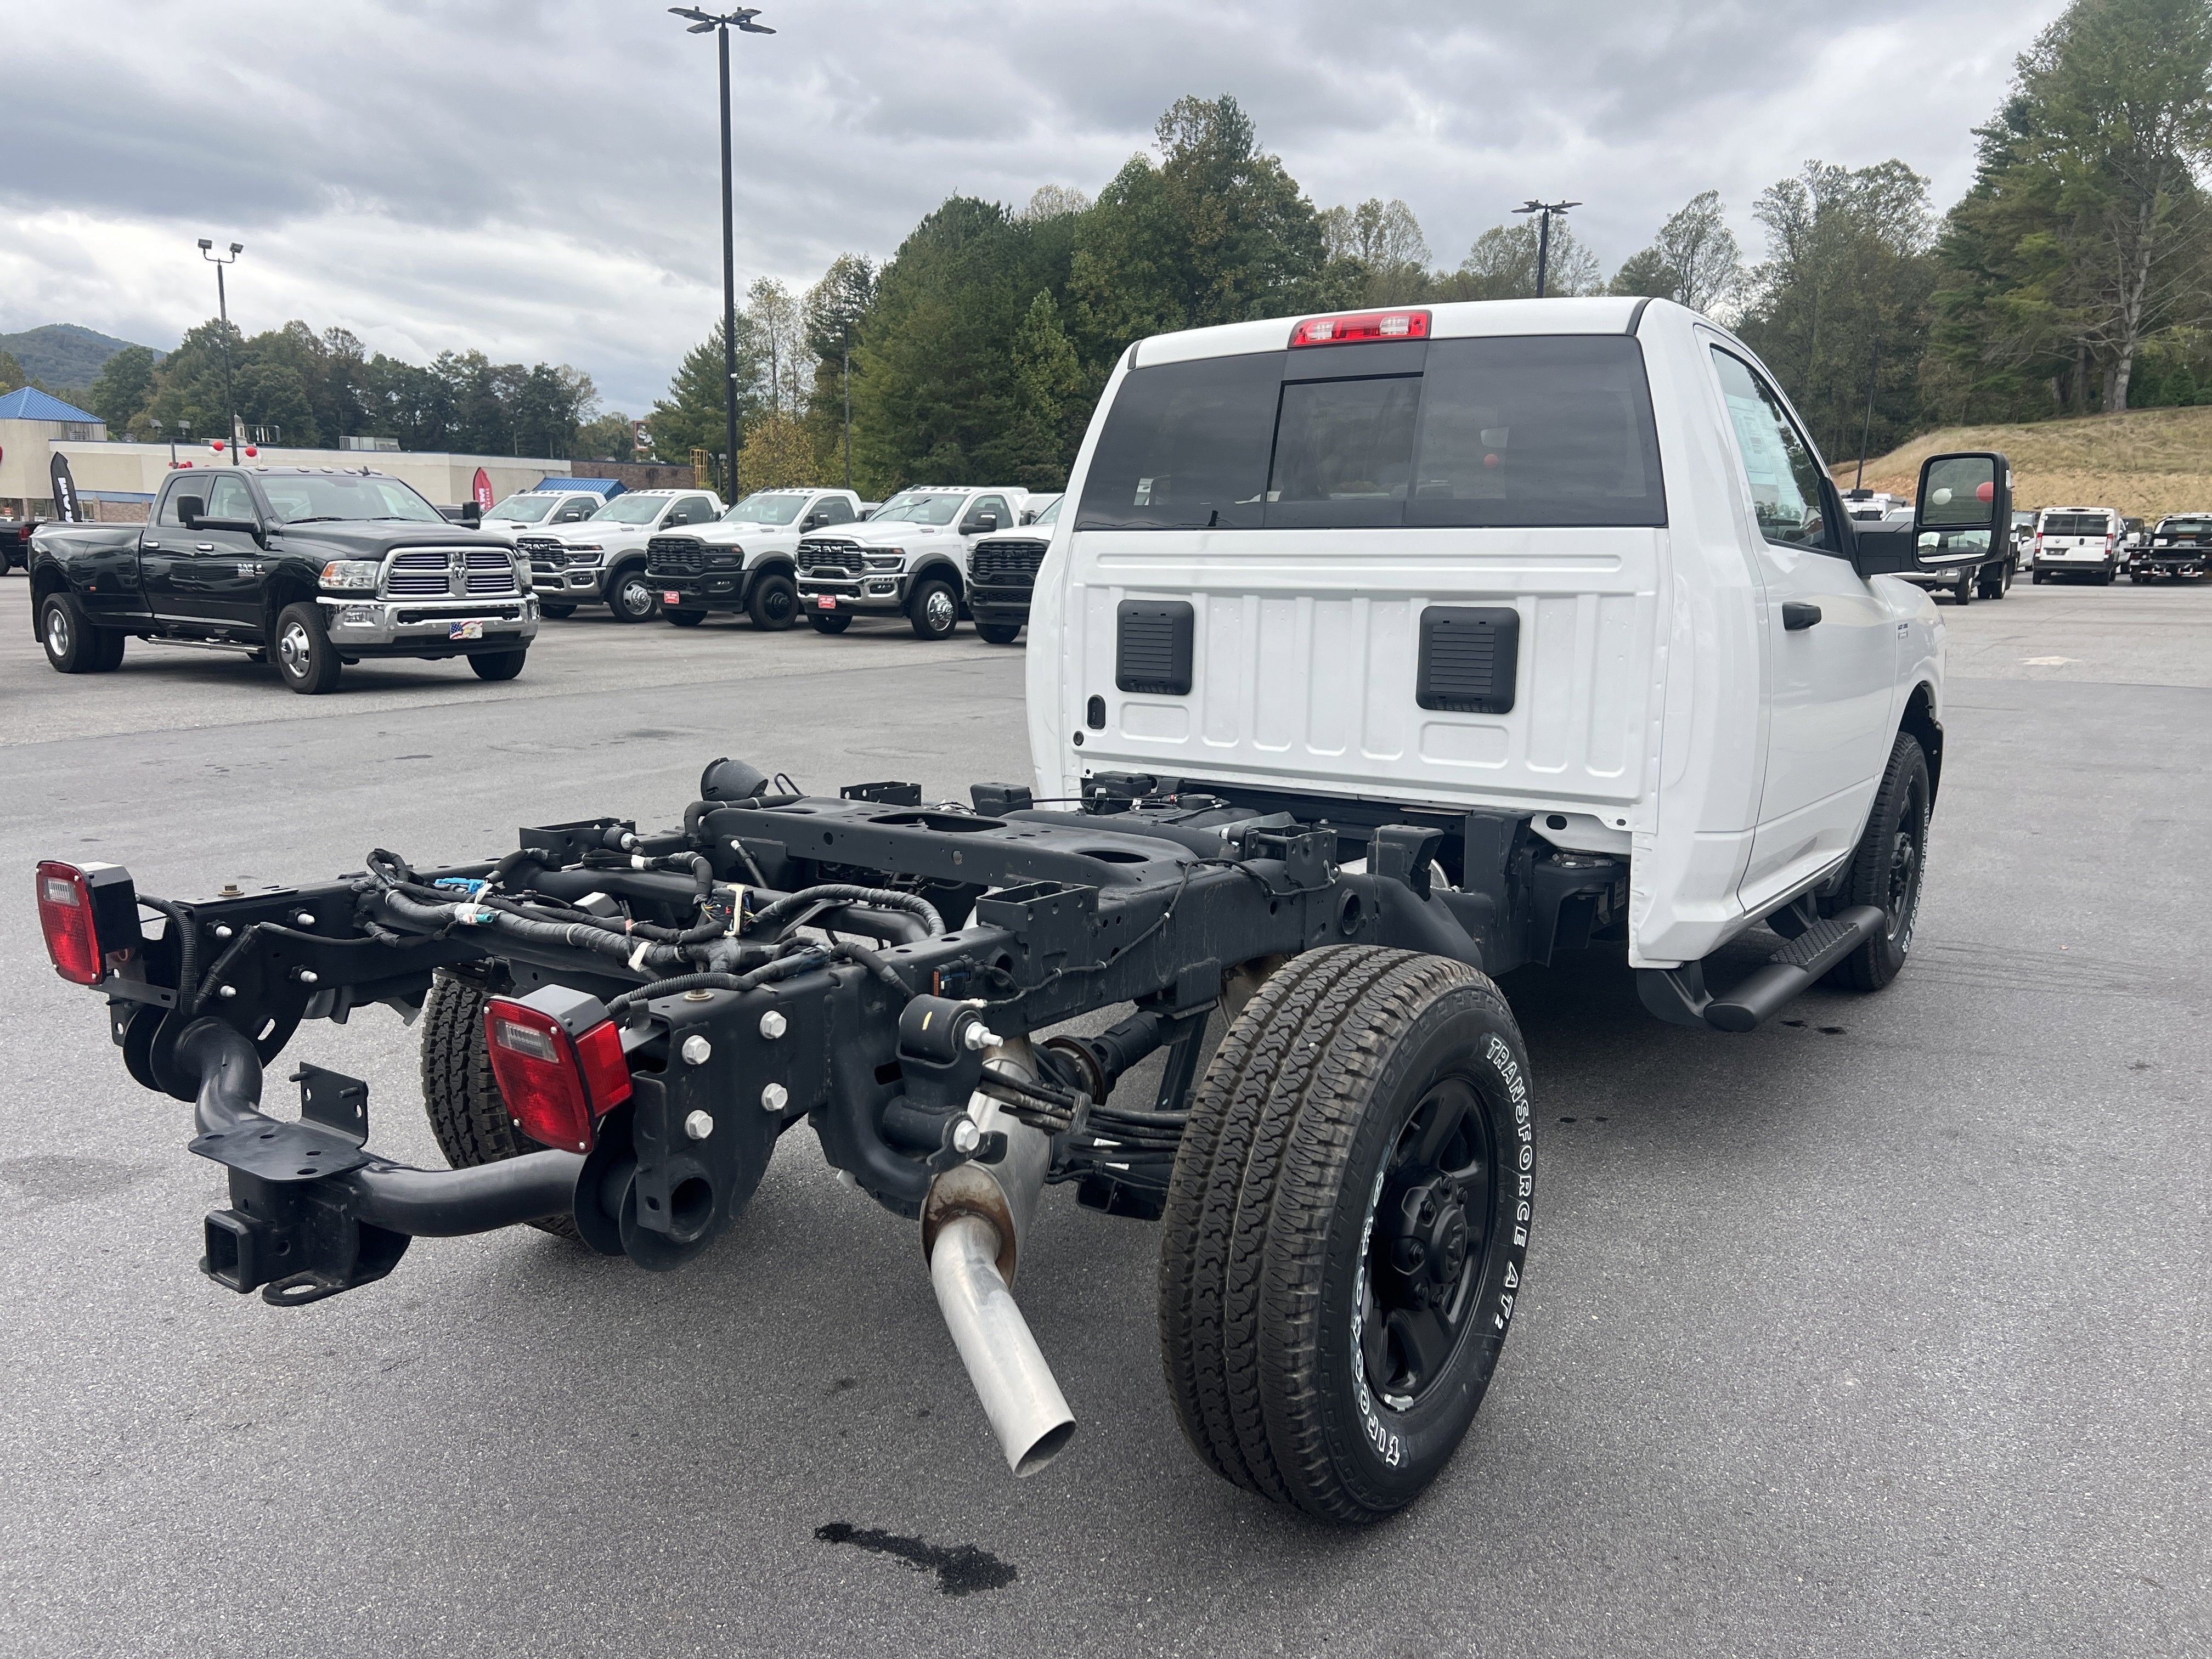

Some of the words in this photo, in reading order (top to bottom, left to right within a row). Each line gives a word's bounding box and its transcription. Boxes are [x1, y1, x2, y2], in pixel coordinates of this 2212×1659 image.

[57, 477, 74, 523] RAM
[810, 544, 843, 553] RAM
[1486, 1037, 1533, 1248] TRANSFORCE
